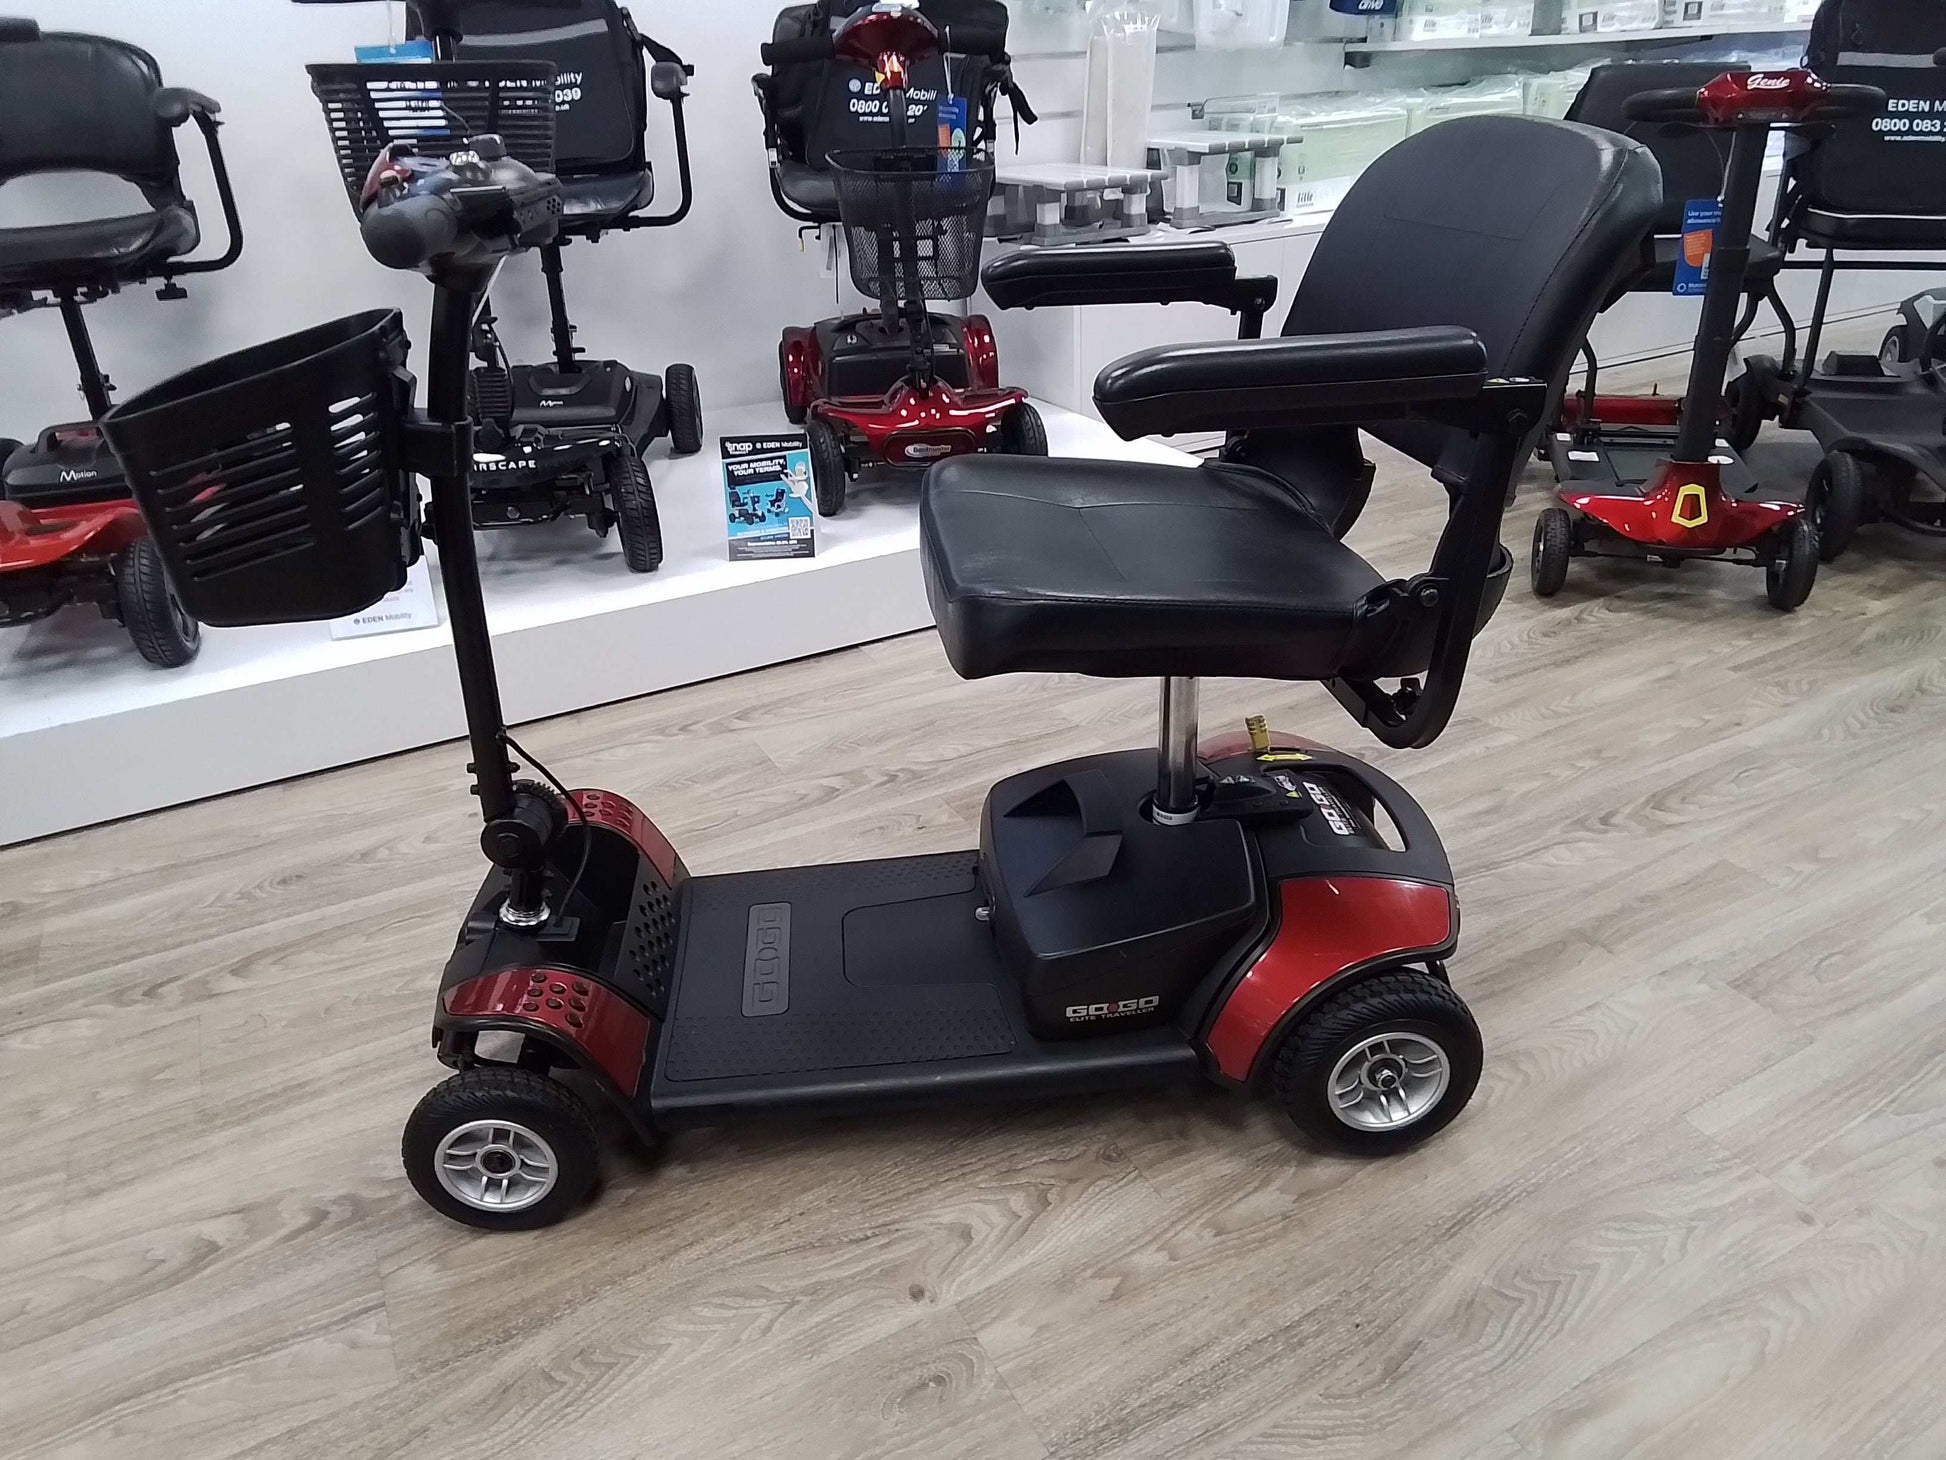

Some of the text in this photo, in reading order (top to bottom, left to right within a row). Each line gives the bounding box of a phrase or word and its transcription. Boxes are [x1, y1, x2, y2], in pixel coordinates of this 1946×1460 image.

[1746, 73, 1790, 90] Genie
[849, 98, 880, 113] 0800
[1887, 99, 1930, 112] EDEN
[1871, 118, 1910, 131] 0800
[1912, 119, 1941, 132] 083
[473, 460, 536, 471] IRSCAPE
[362, 617, 384, 625] EDEN
[1101, 1007, 1154, 1018] TRAVELLER
